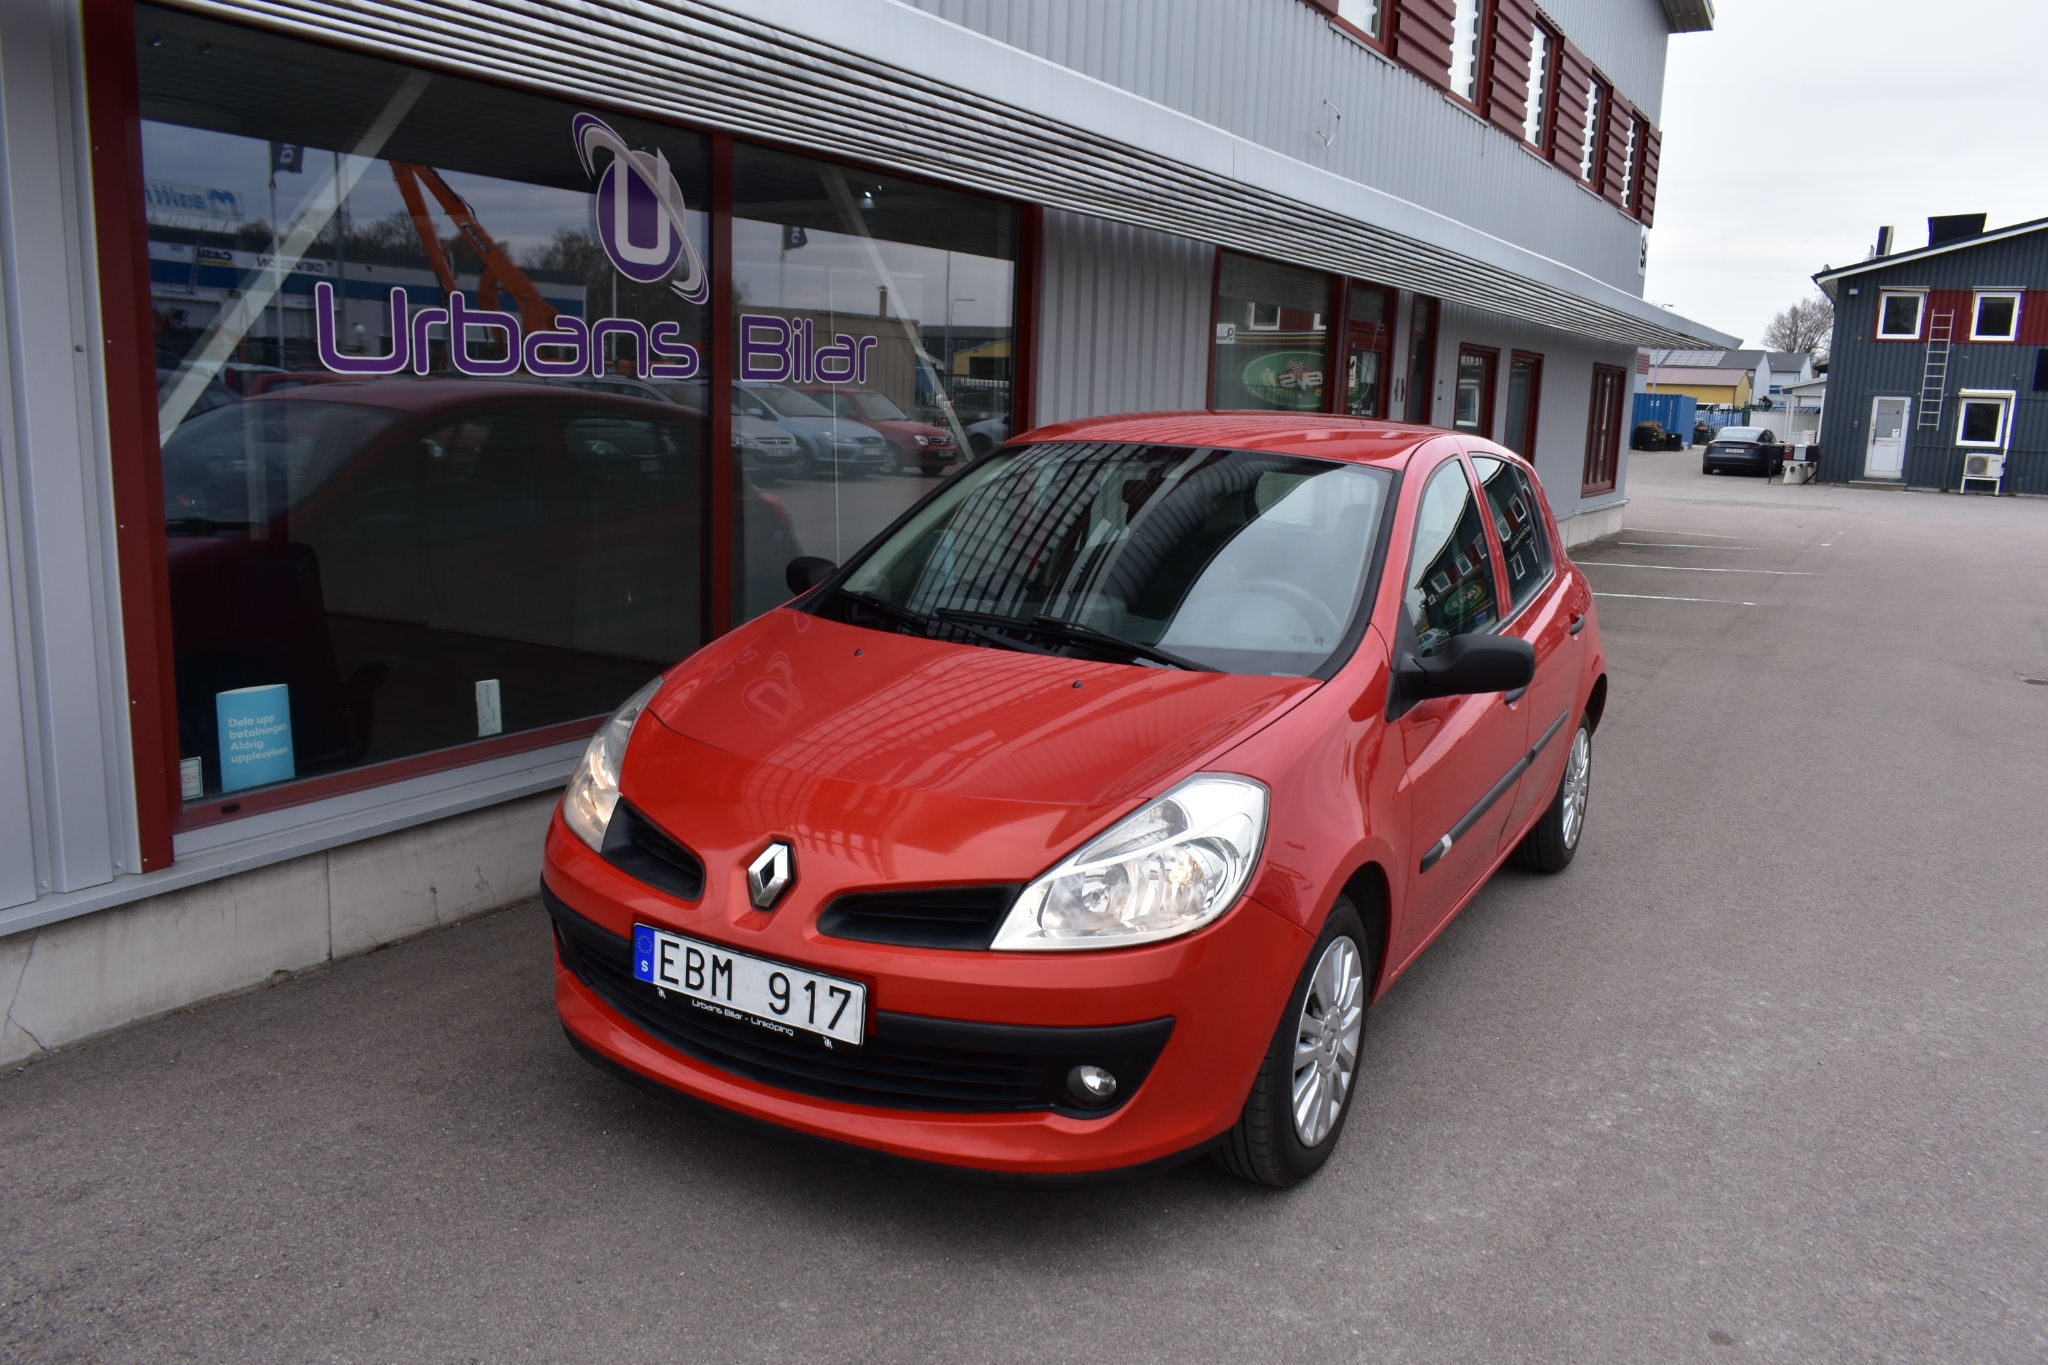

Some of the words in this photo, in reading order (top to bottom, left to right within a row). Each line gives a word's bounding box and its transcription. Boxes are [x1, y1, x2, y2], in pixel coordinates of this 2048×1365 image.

[314, 281, 699, 379] Urbans
[740, 313, 877, 384] Bilar
[228, 717, 254, 727] Dela
[257, 715, 275, 725] upp
[229, 723, 288, 739] betalningen.
[230, 739, 264, 751] Aldrig
[641, 960, 649, 973] S
[659, 938, 733, 1001] EBM
[768, 971, 852, 1031] 917
[692, 998, 723, 1015] Urbans
[724, 1008, 743, 1021] Bilar
[750, 1016, 794, 1037] Linköping
